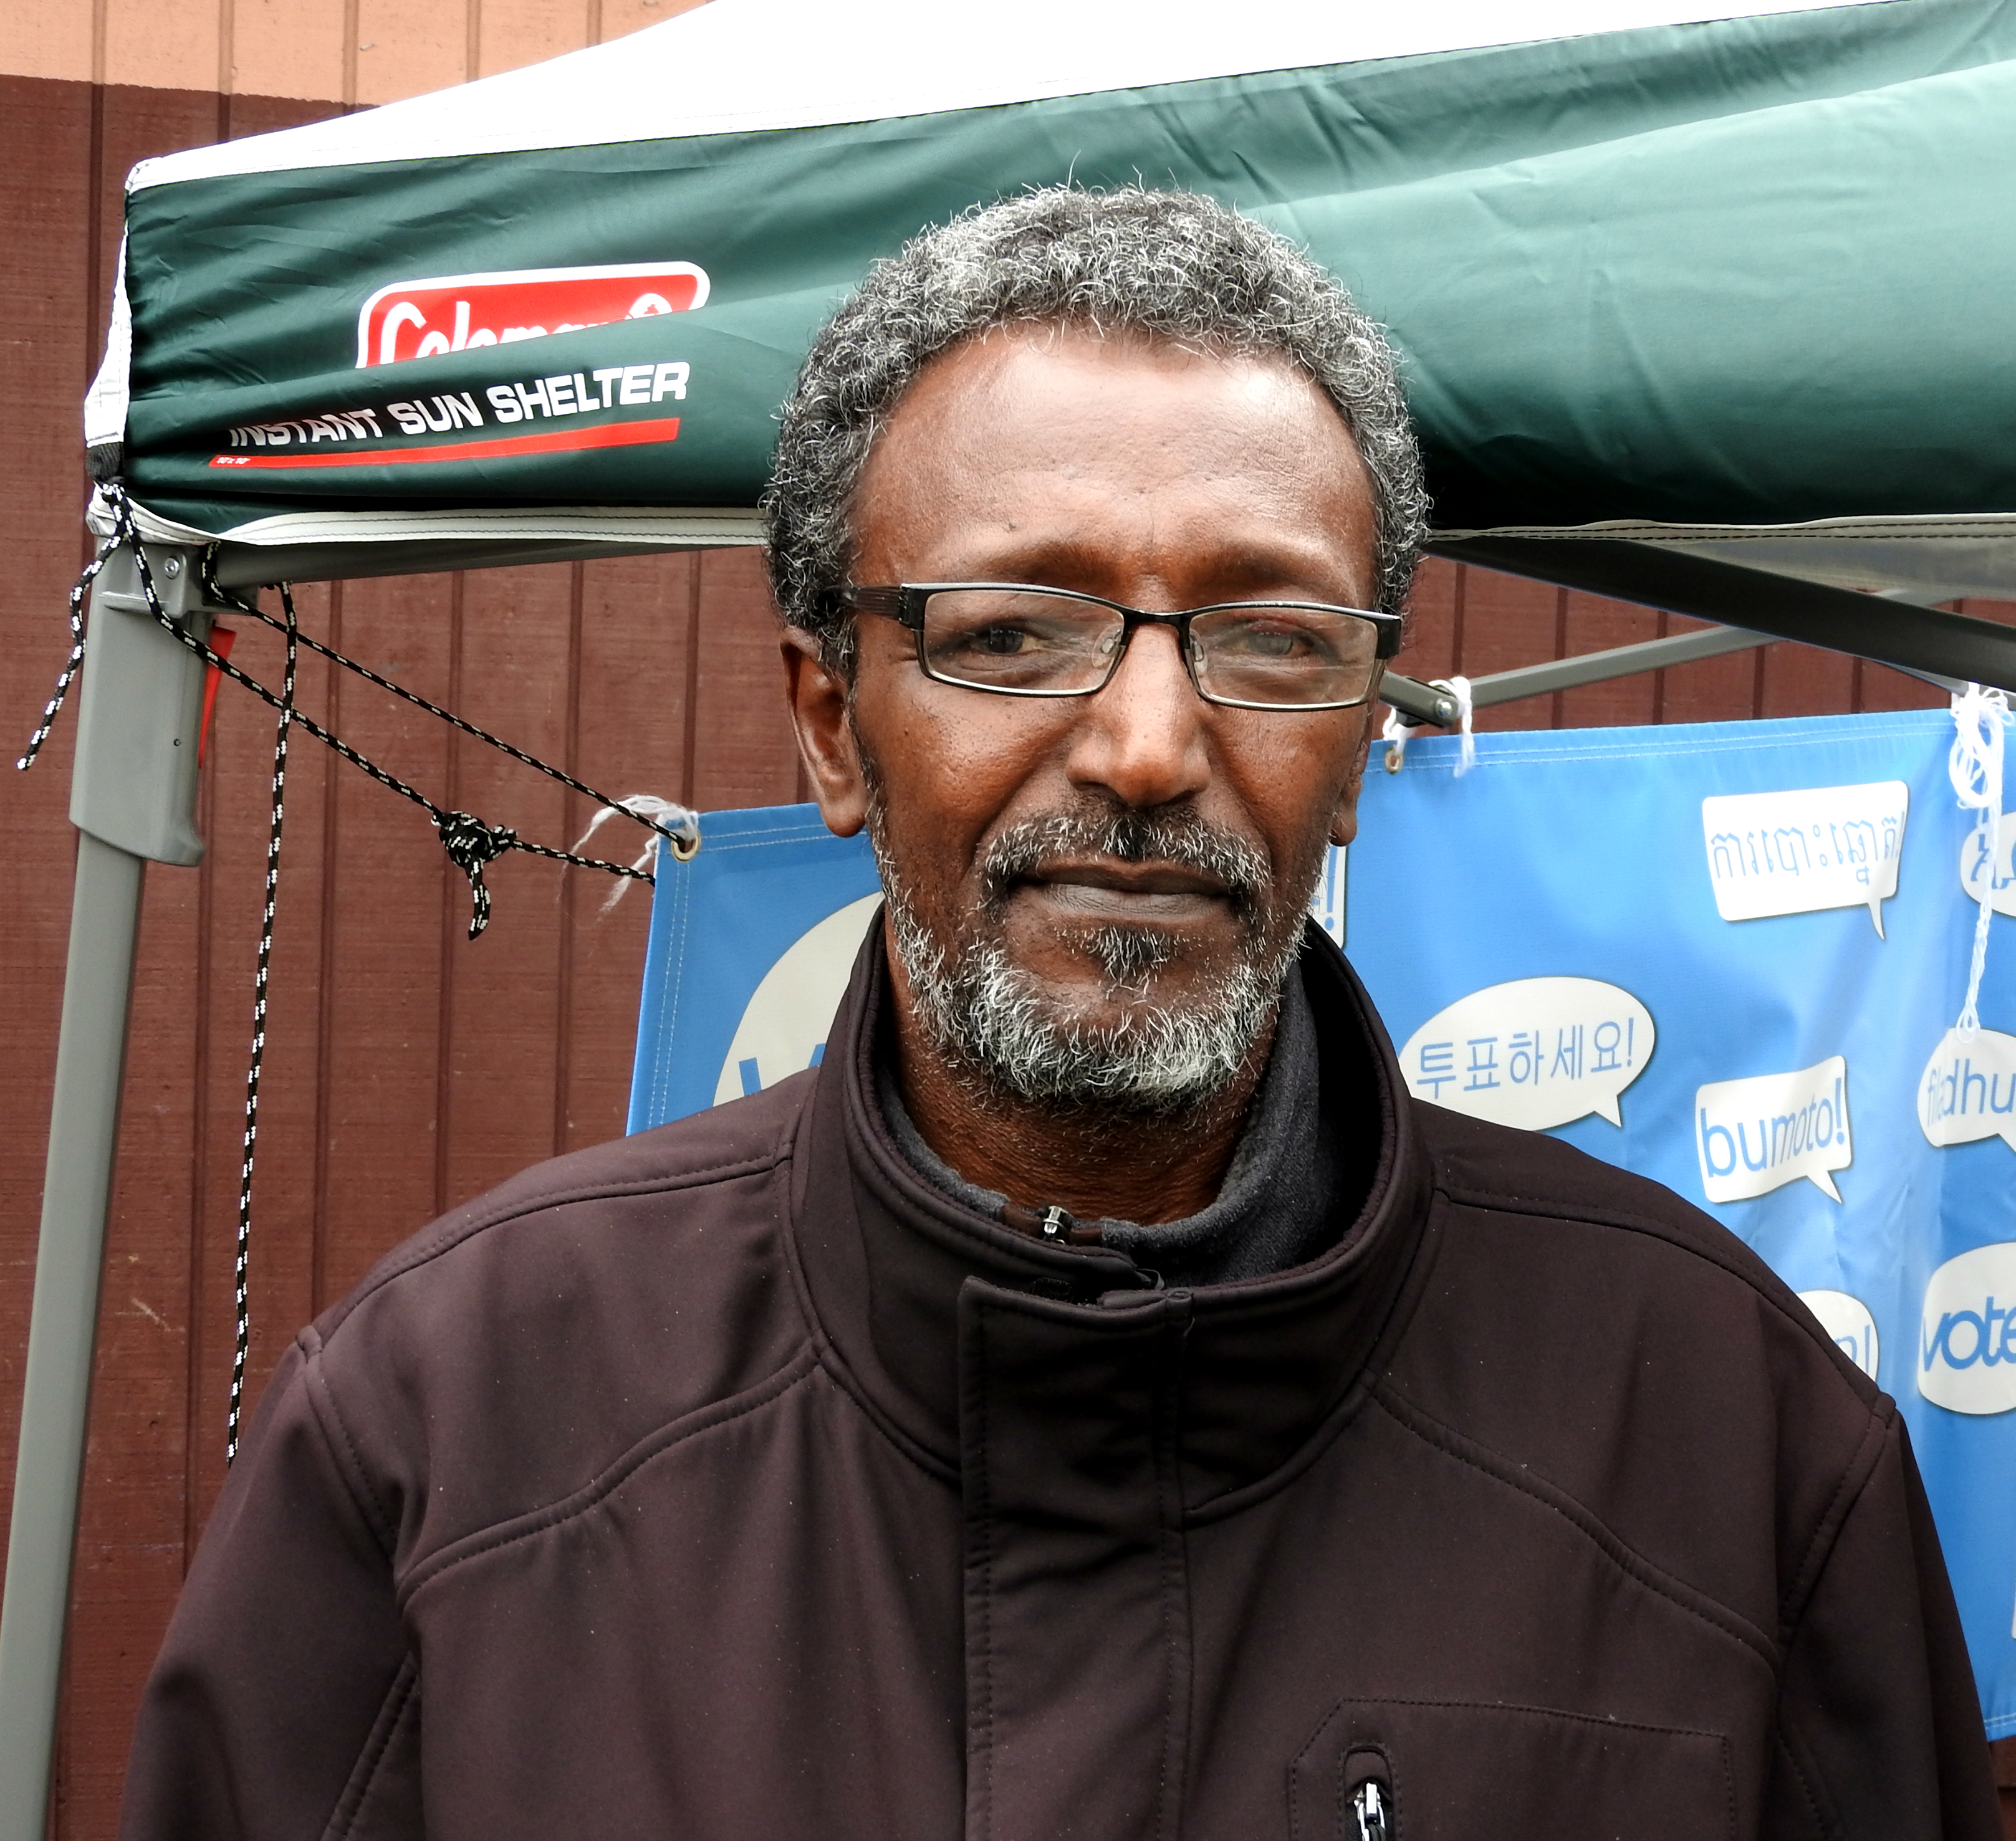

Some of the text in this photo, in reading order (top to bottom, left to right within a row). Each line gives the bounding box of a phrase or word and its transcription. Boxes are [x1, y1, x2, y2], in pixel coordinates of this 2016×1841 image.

[229, 361, 690, 446] INSTANT SUN SHELTER
[1416, 1018, 1634, 1099] 투표하세요!
[1700, 1078, 1845, 1178] bumoto!
